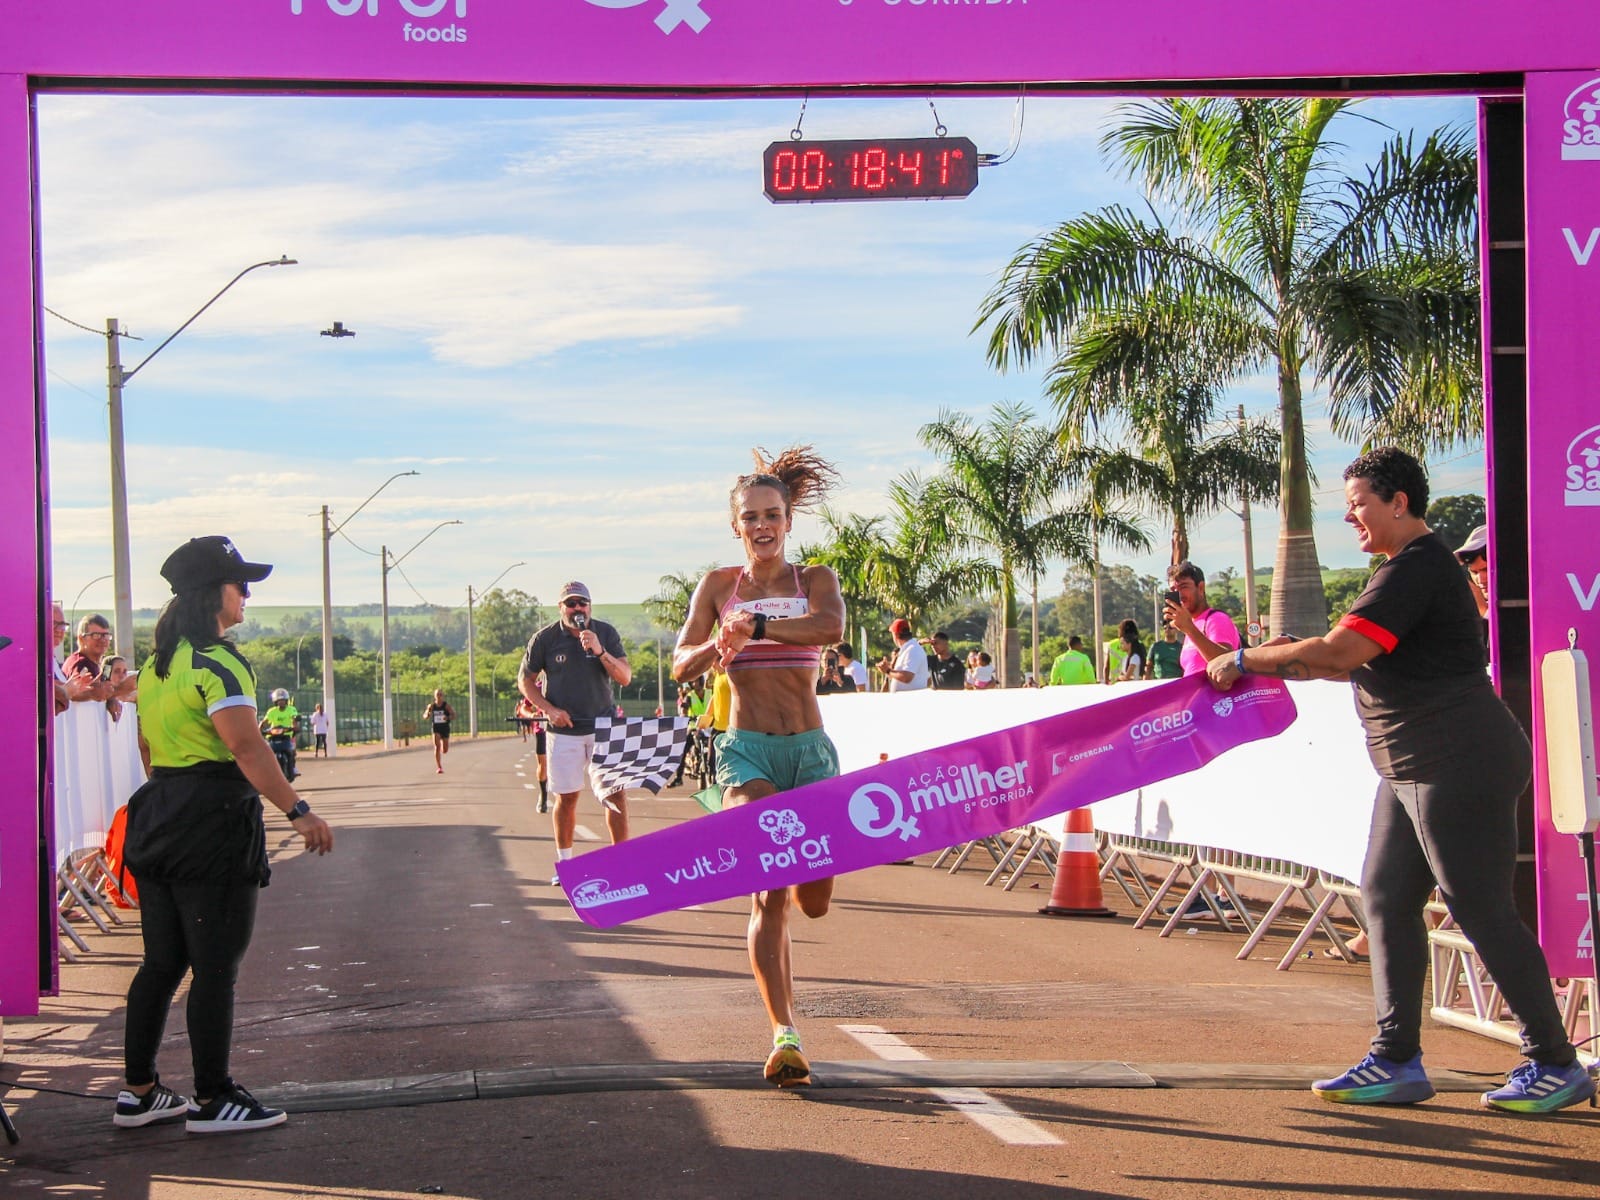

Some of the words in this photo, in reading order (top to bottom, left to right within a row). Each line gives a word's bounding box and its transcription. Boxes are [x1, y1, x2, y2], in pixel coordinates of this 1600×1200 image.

[403, 22, 468, 43] foods
[1129, 709, 1194, 741] COCRED
[1068, 743, 1114, 763] COPERCANA
[907, 765, 960, 789] AÇÃO
[909, 760, 1029, 813] mulher
[980, 785, 1035, 810] CORRIDA
[664, 855, 718, 885] vult
[758, 846, 799, 873] Pot
[807, 856, 834, 870] foods
